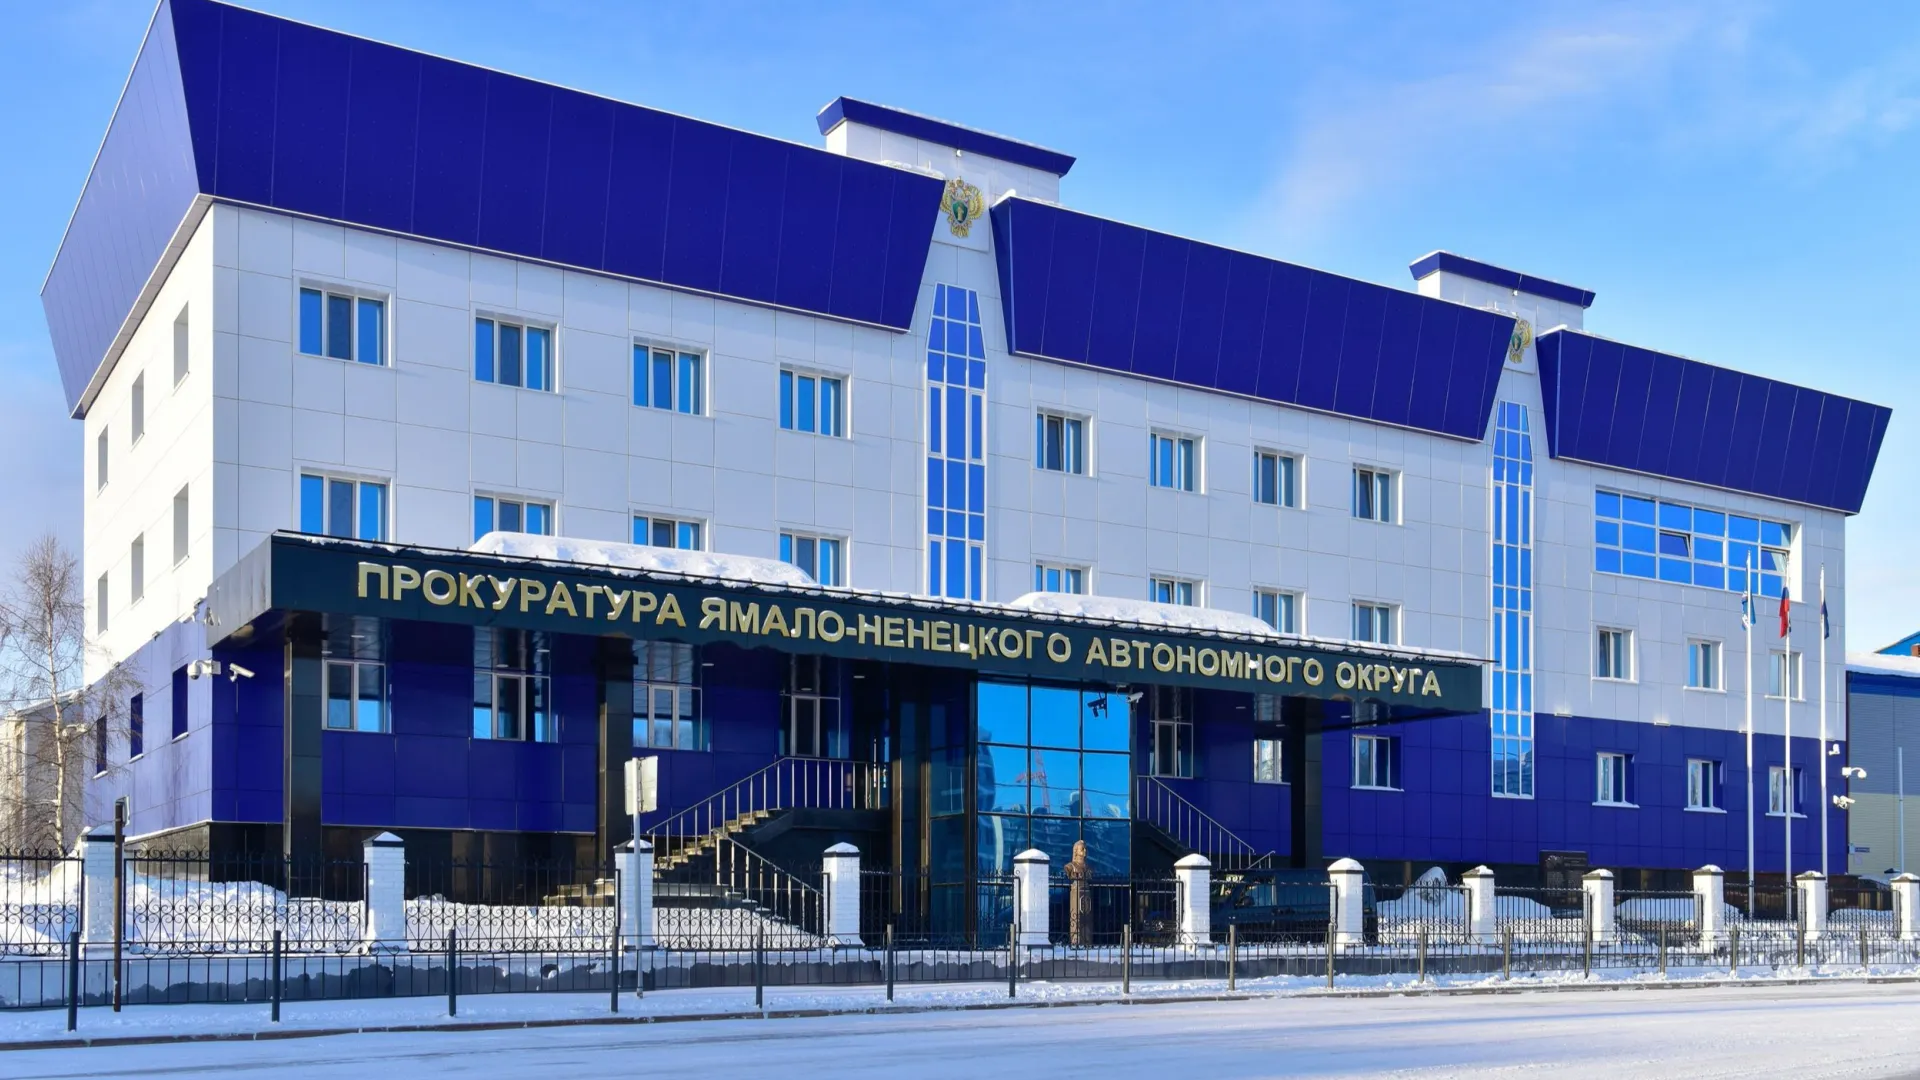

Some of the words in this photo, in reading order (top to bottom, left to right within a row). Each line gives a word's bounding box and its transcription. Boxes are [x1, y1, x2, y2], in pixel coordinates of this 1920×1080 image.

[357, 561, 687, 627] ПРОКУРАТУРА
[699, 597, 1072, 662] ЯМАЛО-НЕНЕЦКОГО
[1085, 637, 1324, 686] АВТОНОМНОГО
[1335, 661, 1442, 697] ОКРУГА
